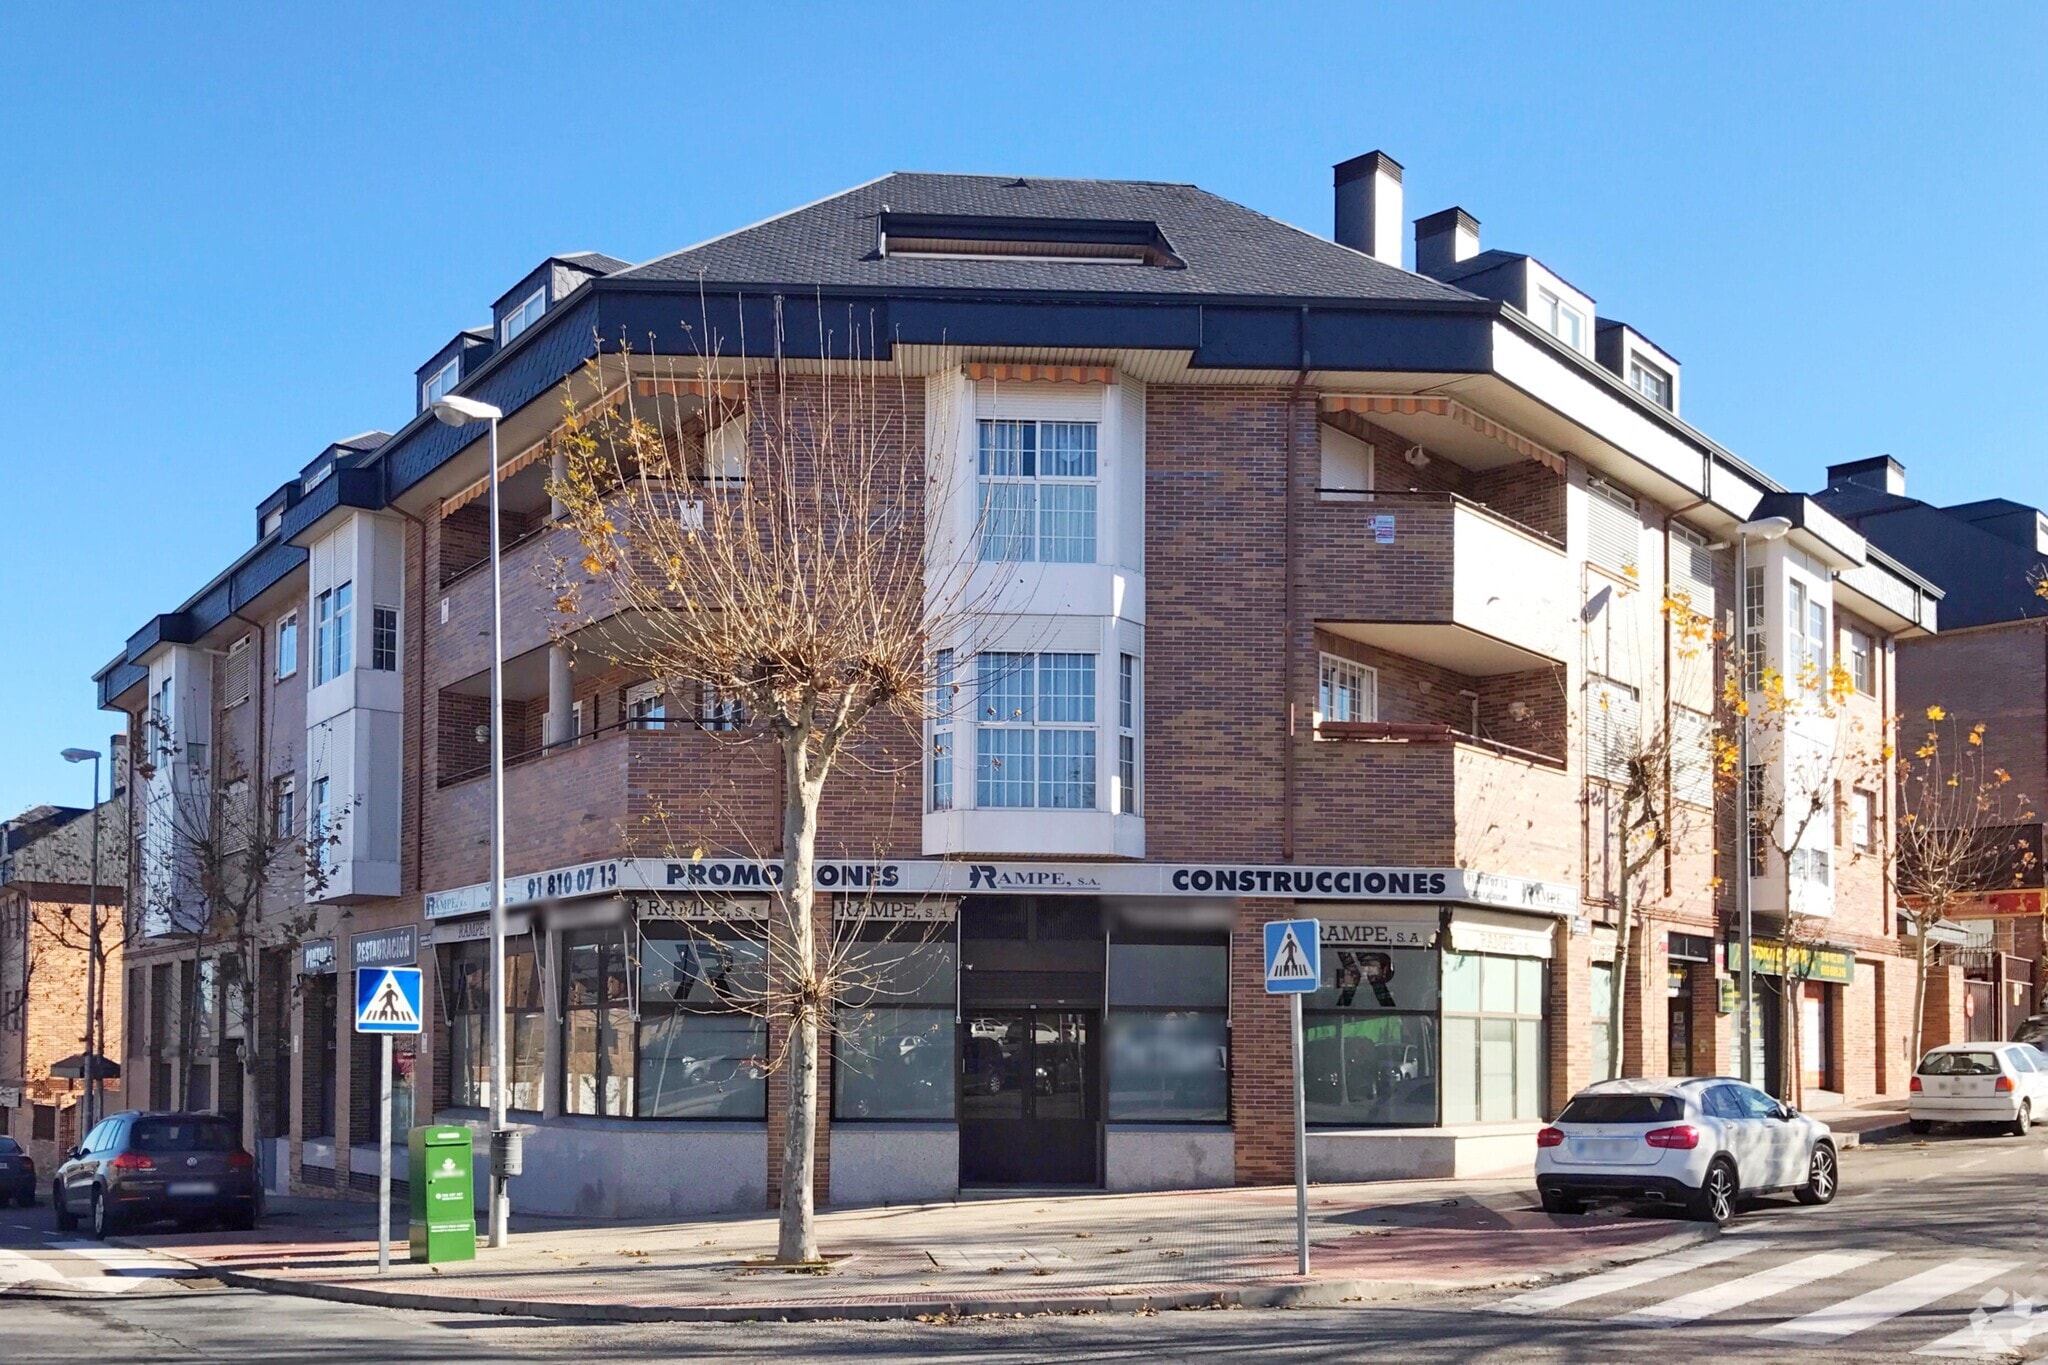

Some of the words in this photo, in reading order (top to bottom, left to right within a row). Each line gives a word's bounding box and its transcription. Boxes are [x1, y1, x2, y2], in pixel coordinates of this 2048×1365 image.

[527, 877, 542, 900] 91
[547, 872, 573, 896] 810
[577, 867, 595, 892] 07
[600, 863, 617, 888] 13
[667, 863, 899, 886] PROMOONES
[1172, 869, 1446, 894] CONSTRUCCIONES
[356, 931, 410, 963] RESTAURACIÓN
